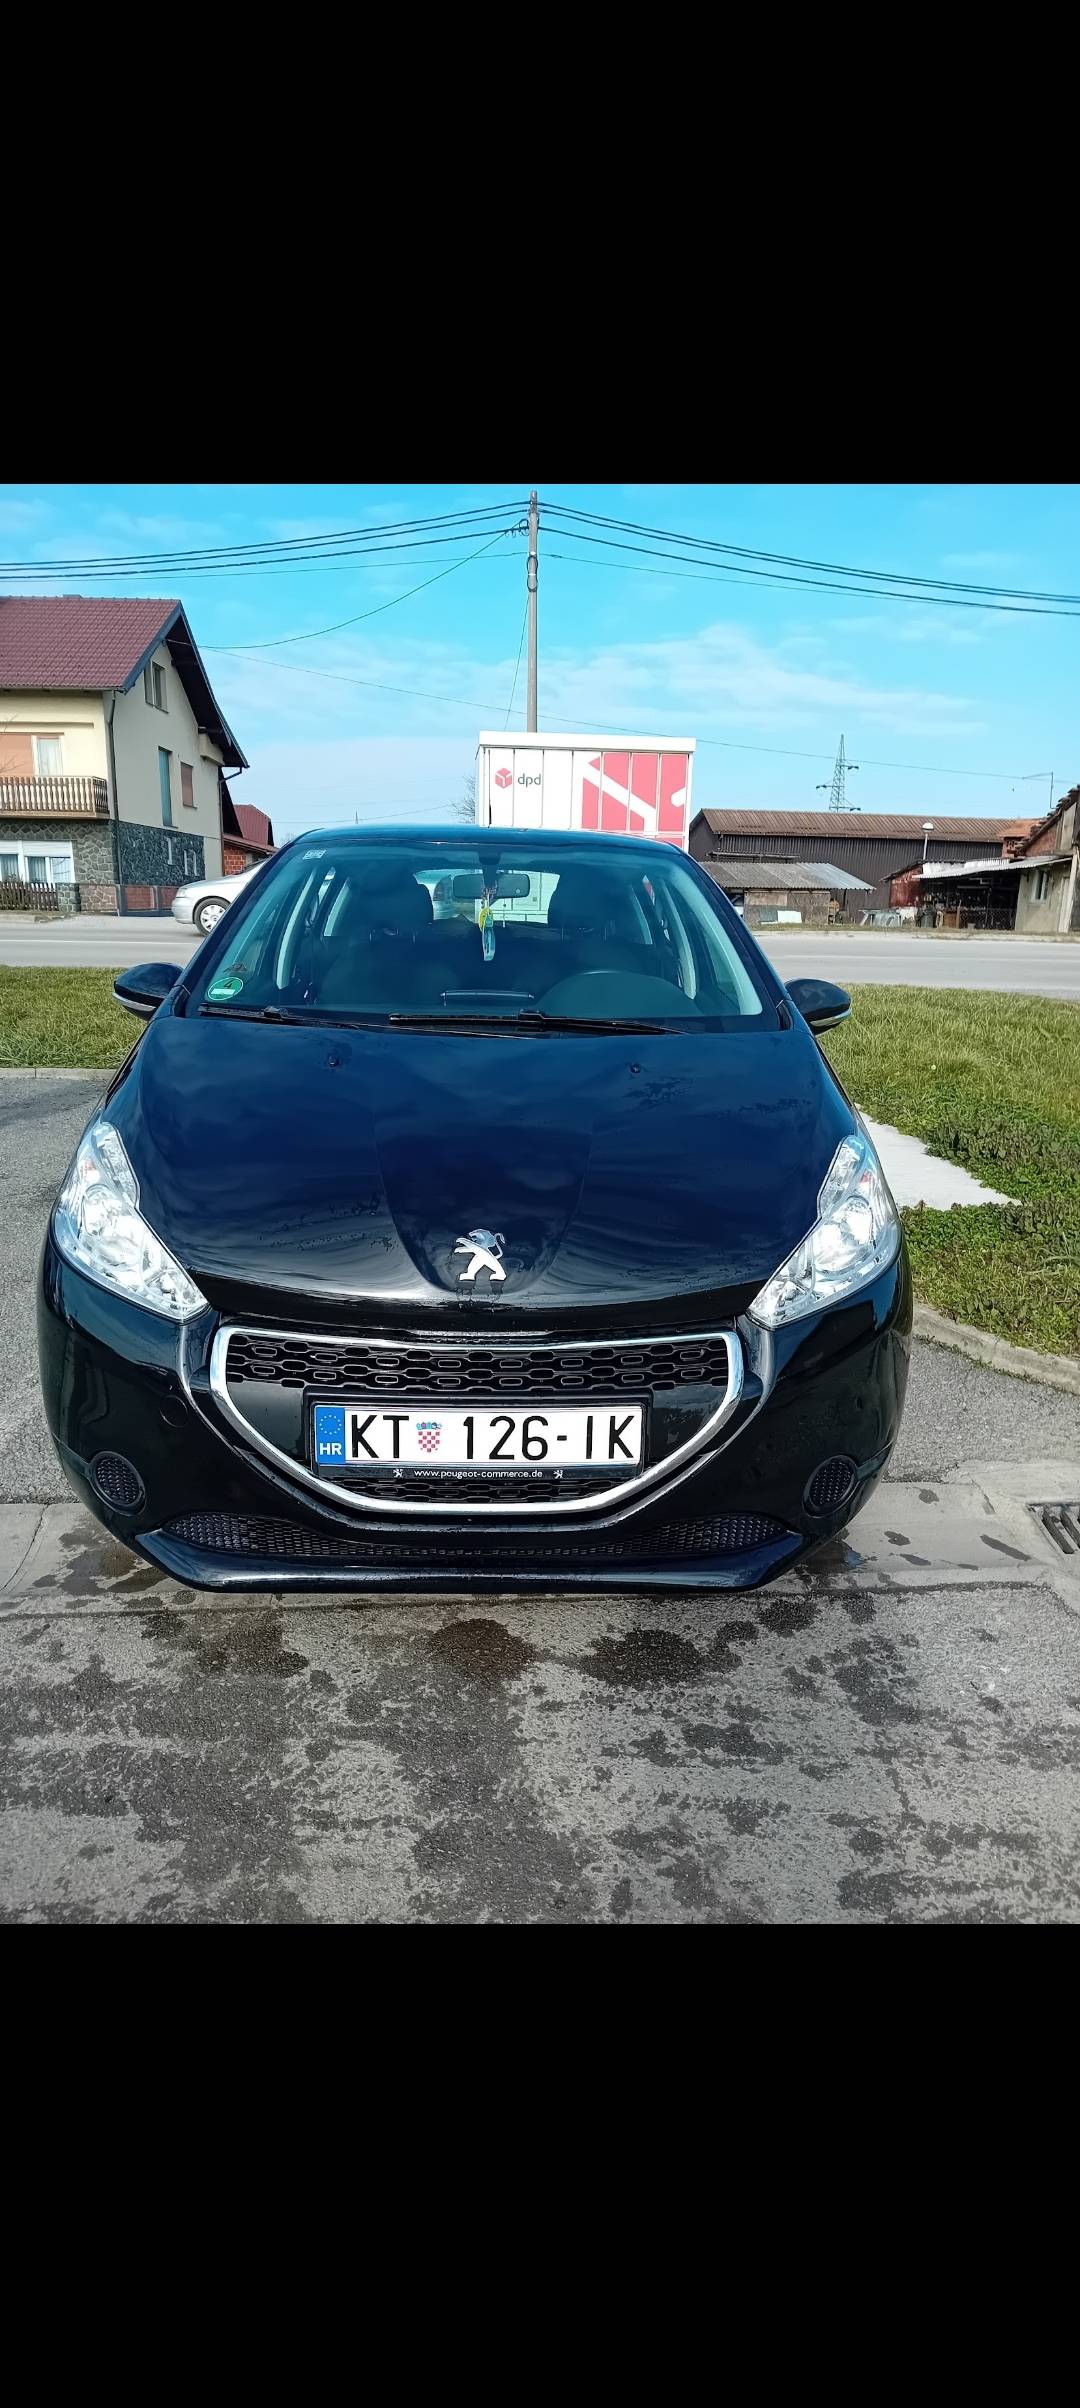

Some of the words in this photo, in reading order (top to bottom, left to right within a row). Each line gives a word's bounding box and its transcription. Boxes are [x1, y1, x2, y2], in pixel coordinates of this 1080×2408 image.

[517, 773, 542, 787] dpd
[351, 1414, 409, 1459] KT
[319, 1442, 342, 1456] HR
[414, 1469, 543, 1479] www.peugeot-commerce.de
